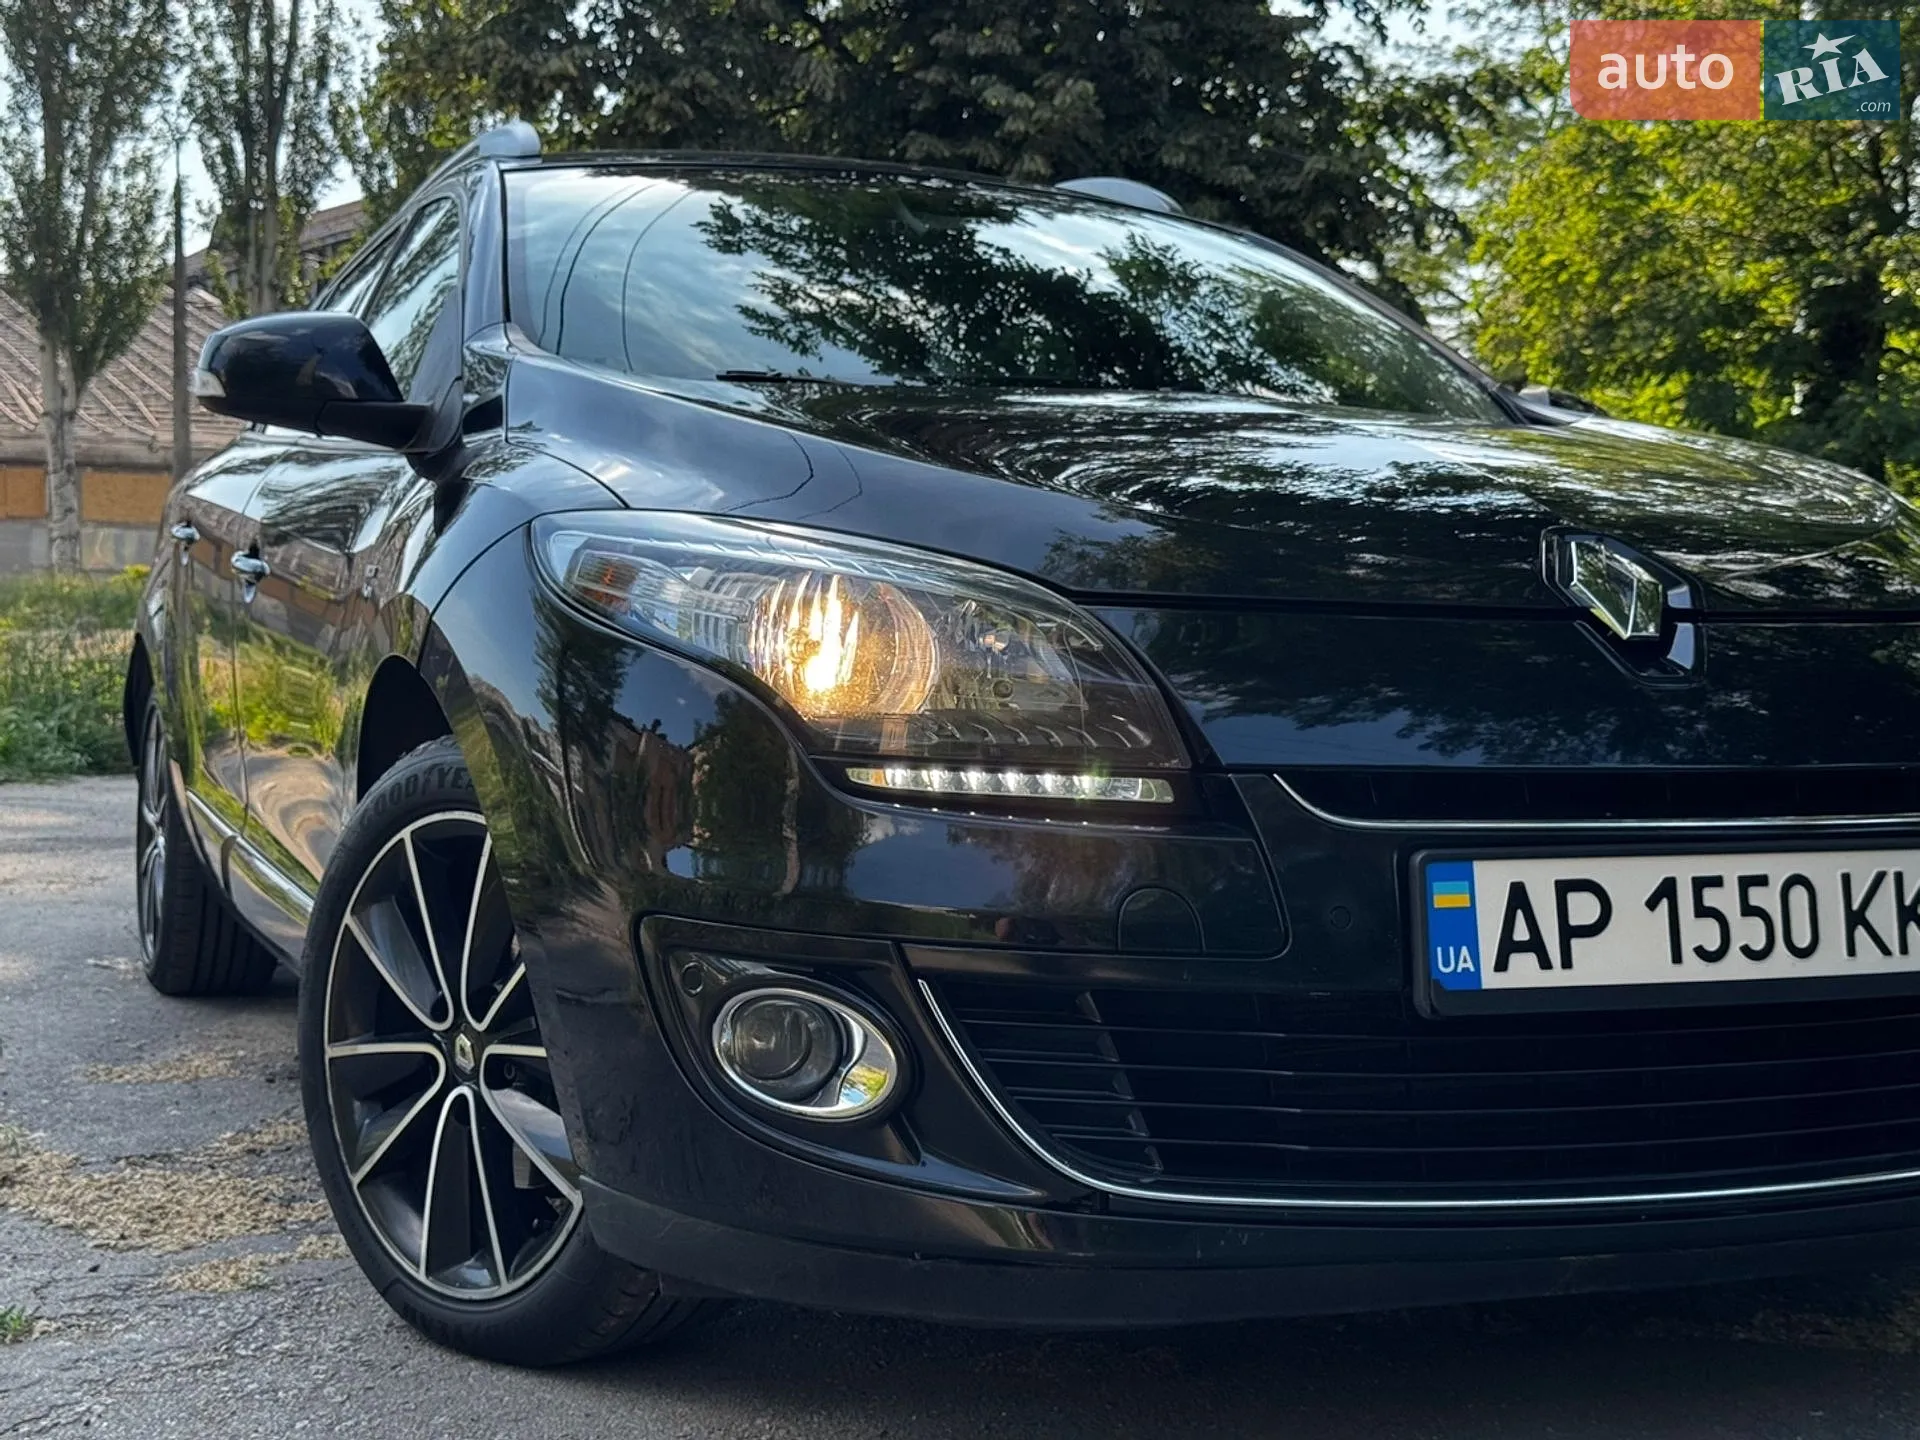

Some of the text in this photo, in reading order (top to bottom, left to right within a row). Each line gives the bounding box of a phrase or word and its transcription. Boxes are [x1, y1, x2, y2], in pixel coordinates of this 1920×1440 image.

[1493, 878, 1613, 973] AP
[1644, 872, 1820, 965] 1550
[1437, 945, 1475, 974] UA
